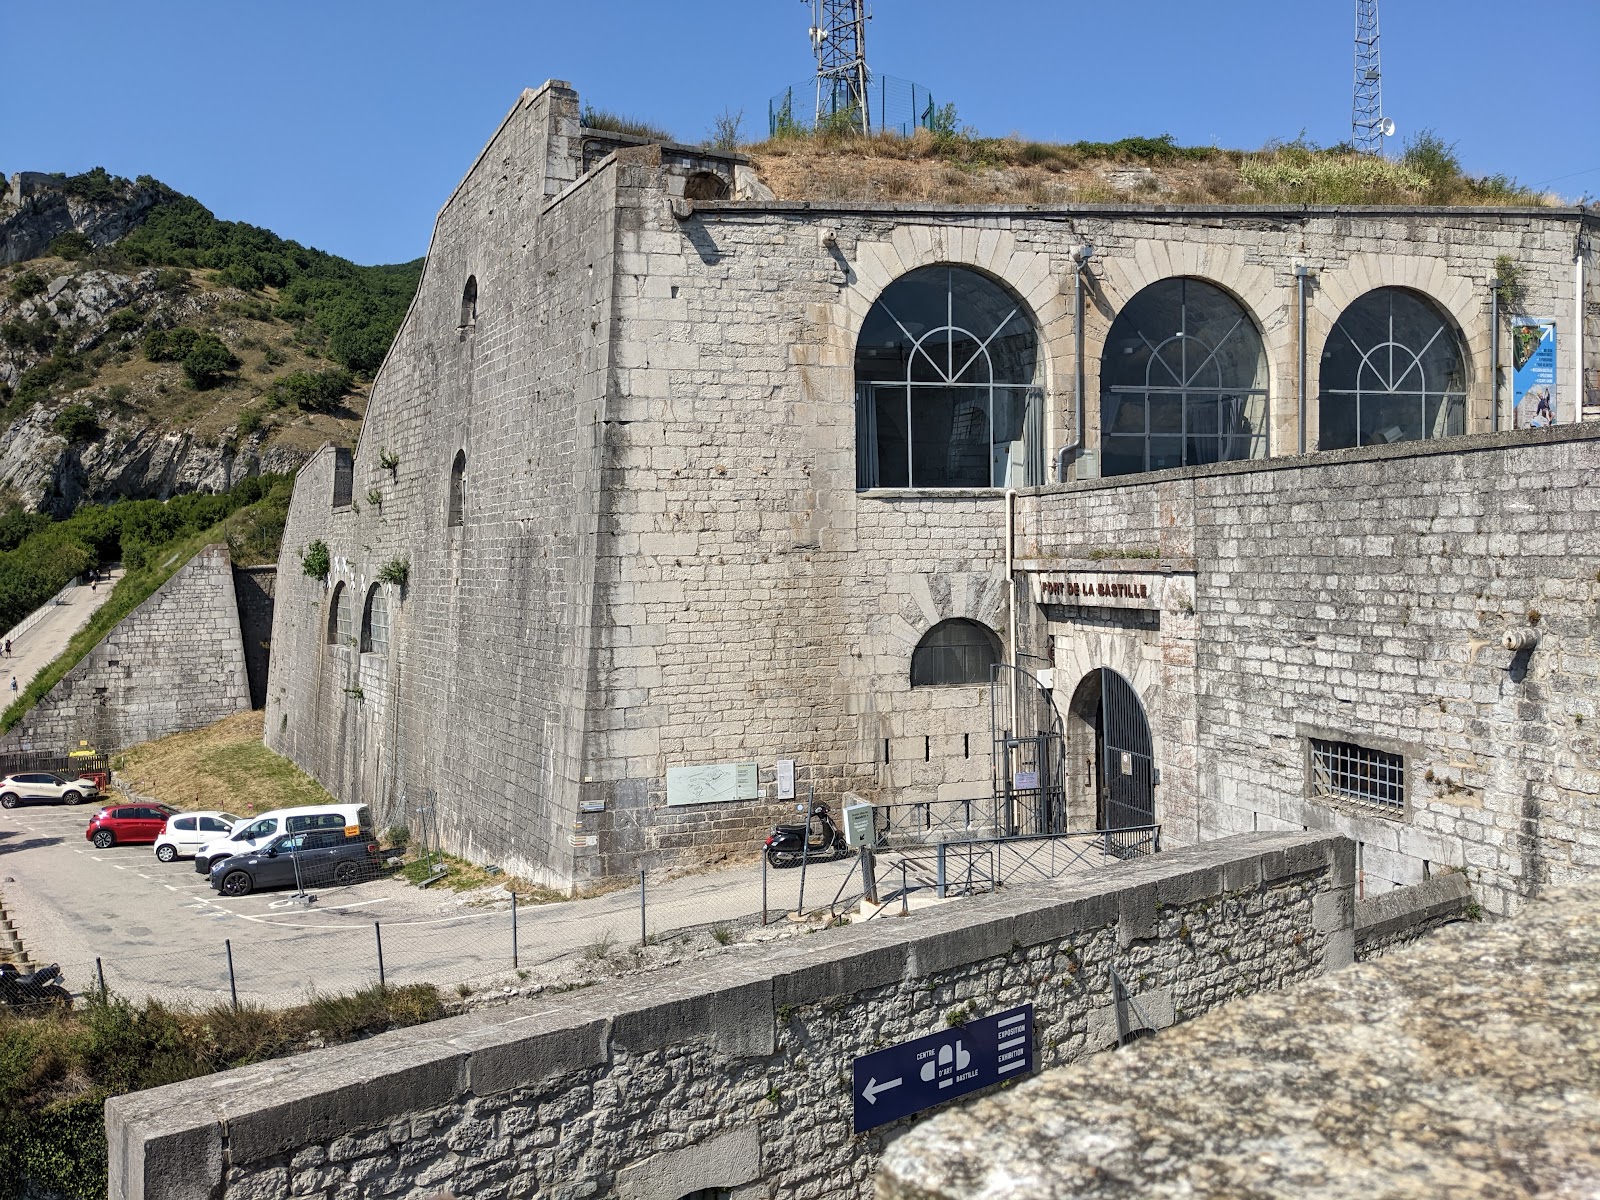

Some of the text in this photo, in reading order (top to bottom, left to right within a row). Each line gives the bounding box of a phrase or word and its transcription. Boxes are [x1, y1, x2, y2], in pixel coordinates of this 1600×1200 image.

[1041, 582, 1148, 599] FORT DE LA BASTILLE
[998, 1024, 1026, 1040] EXPOSITION
[916, 1048, 936, 1061] CENTRE
[998, 1047, 1024, 1063] EXHIBITION
[938, 1066, 953, 1078] D'ART
[956, 1069, 979, 1083] BASTILLE
